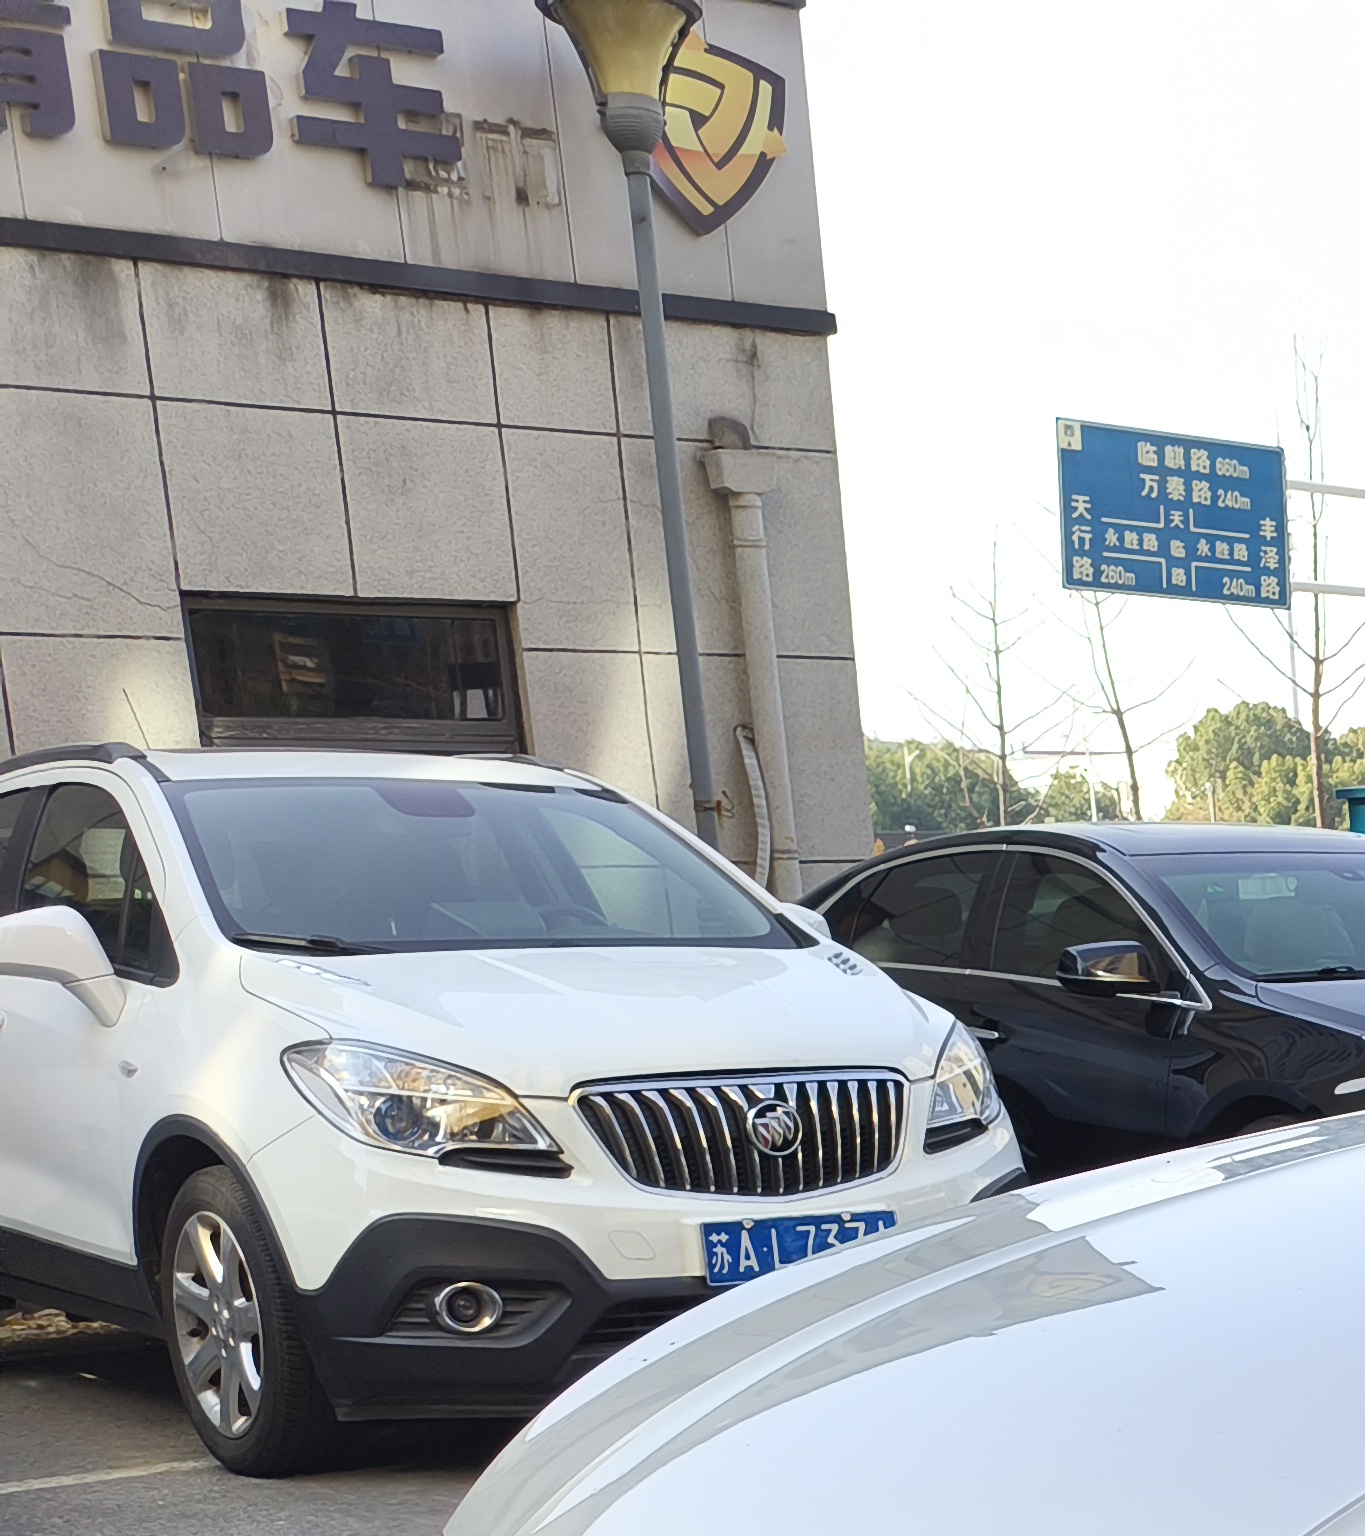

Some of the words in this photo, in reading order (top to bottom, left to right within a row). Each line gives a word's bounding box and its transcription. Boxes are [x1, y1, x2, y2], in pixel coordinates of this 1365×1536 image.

[1136, 441, 1211, 474] 临麒路
[1138, 473, 1212, 506] 万泰路
[1216, 488, 1251, 510] 240m
[1071, 494, 1094, 582] 天行路
[1104, 528, 1159, 552] 永胜路
[1196, 539, 1249, 562] 永胜路
[1259, 517, 1280, 600] 丰泽路
[1100, 565, 1136, 586] 260m
[1222, 577, 1256, 598] 240m
[708, 1219, 886, 1274] 苏A·L737
